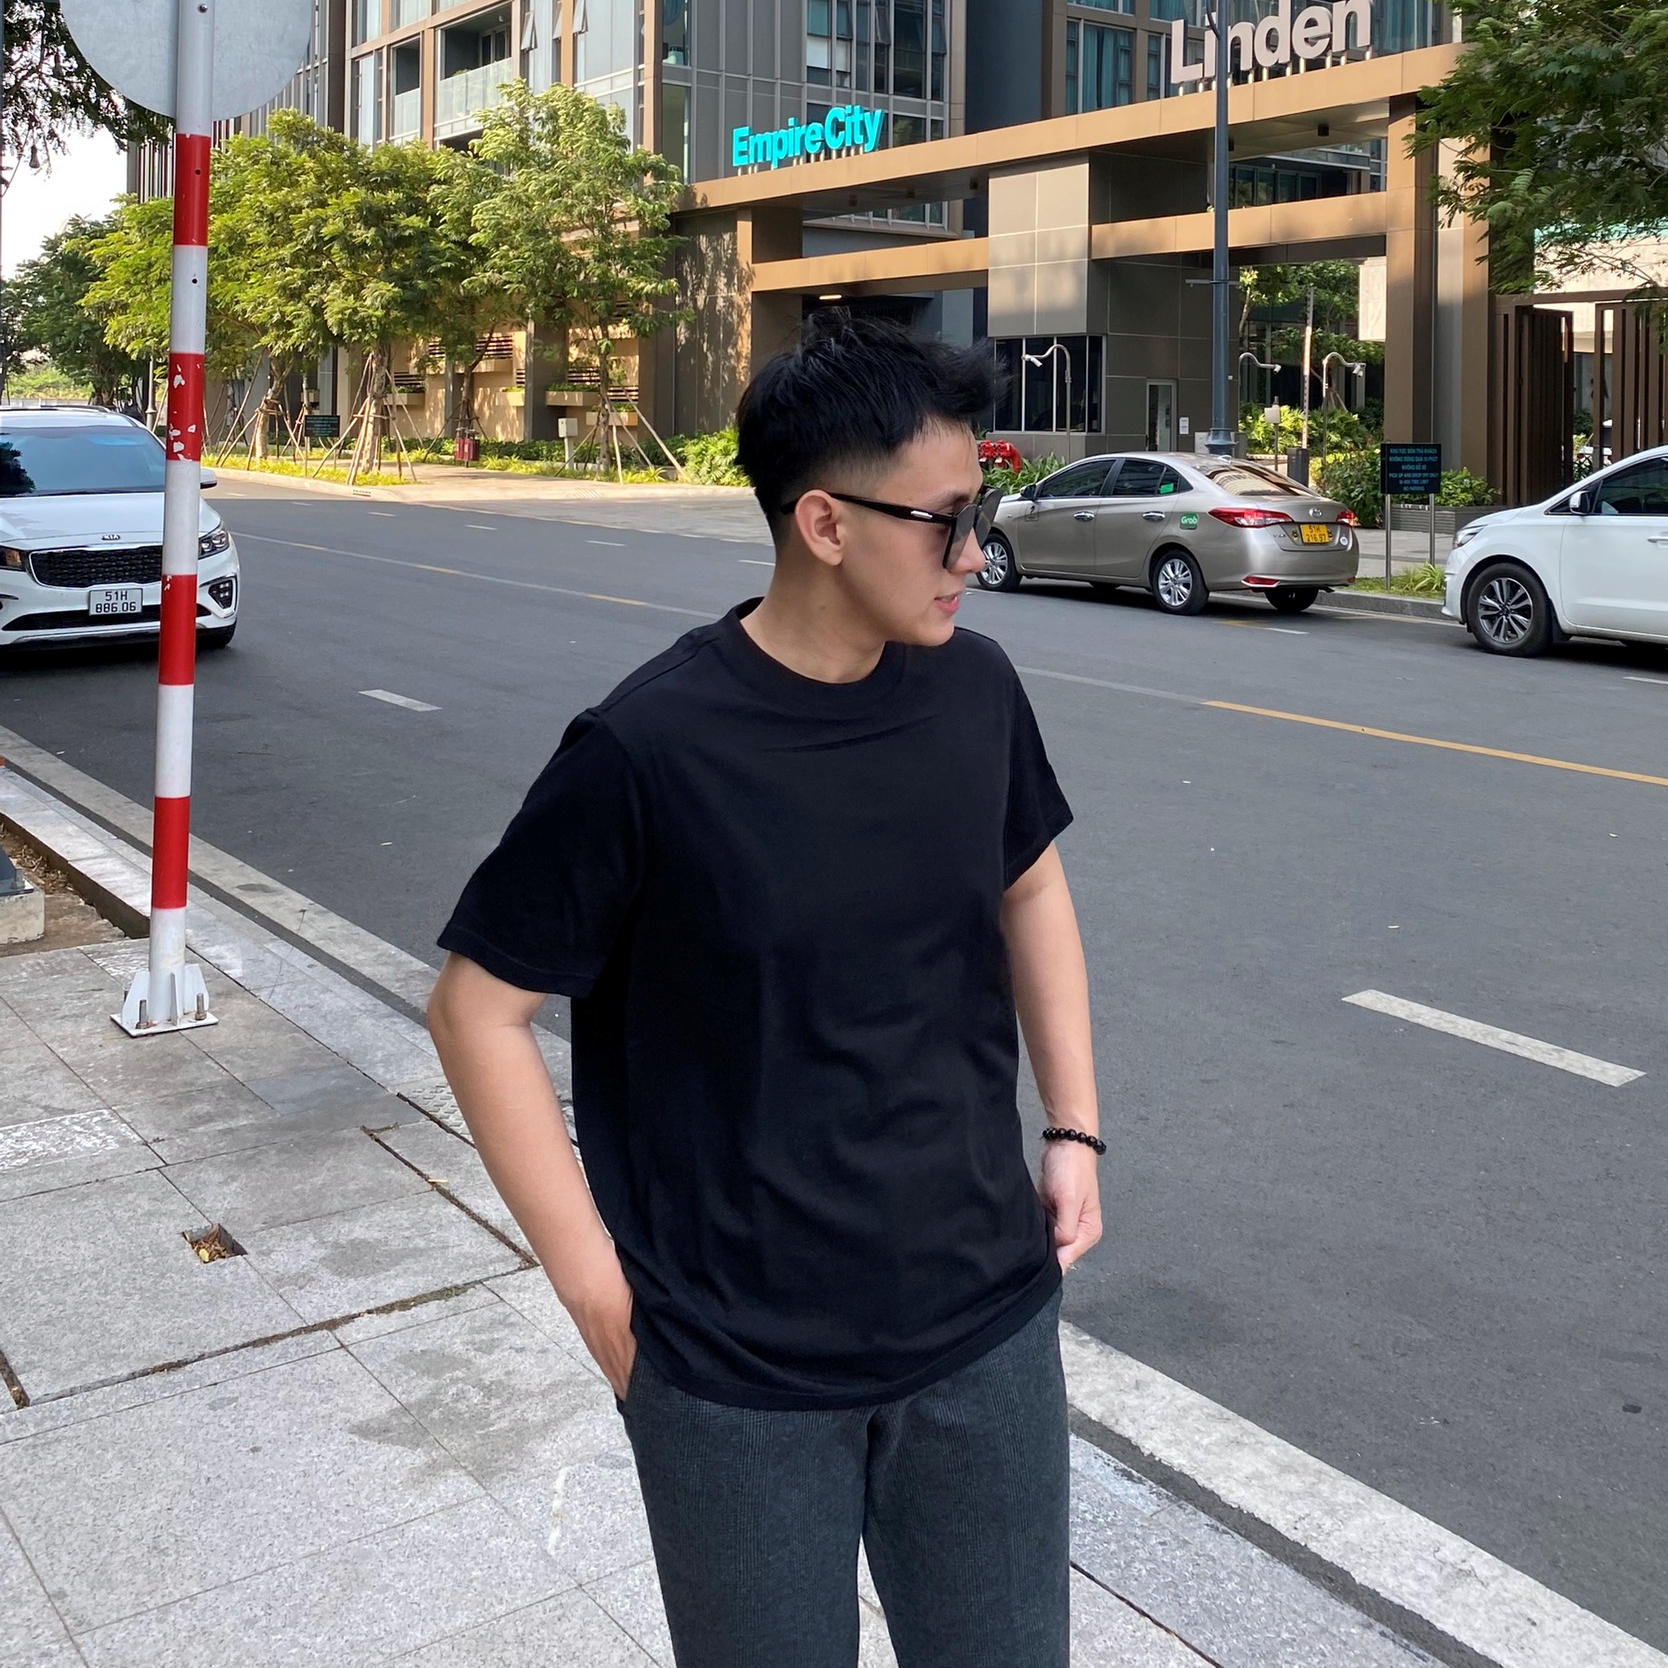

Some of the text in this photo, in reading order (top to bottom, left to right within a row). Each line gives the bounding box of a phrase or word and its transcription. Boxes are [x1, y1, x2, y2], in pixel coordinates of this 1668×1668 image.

[1170, 0, 1372, 84] Linden
[1181, 515, 1198, 525] Grab
[105, 591, 128, 601] 51H
